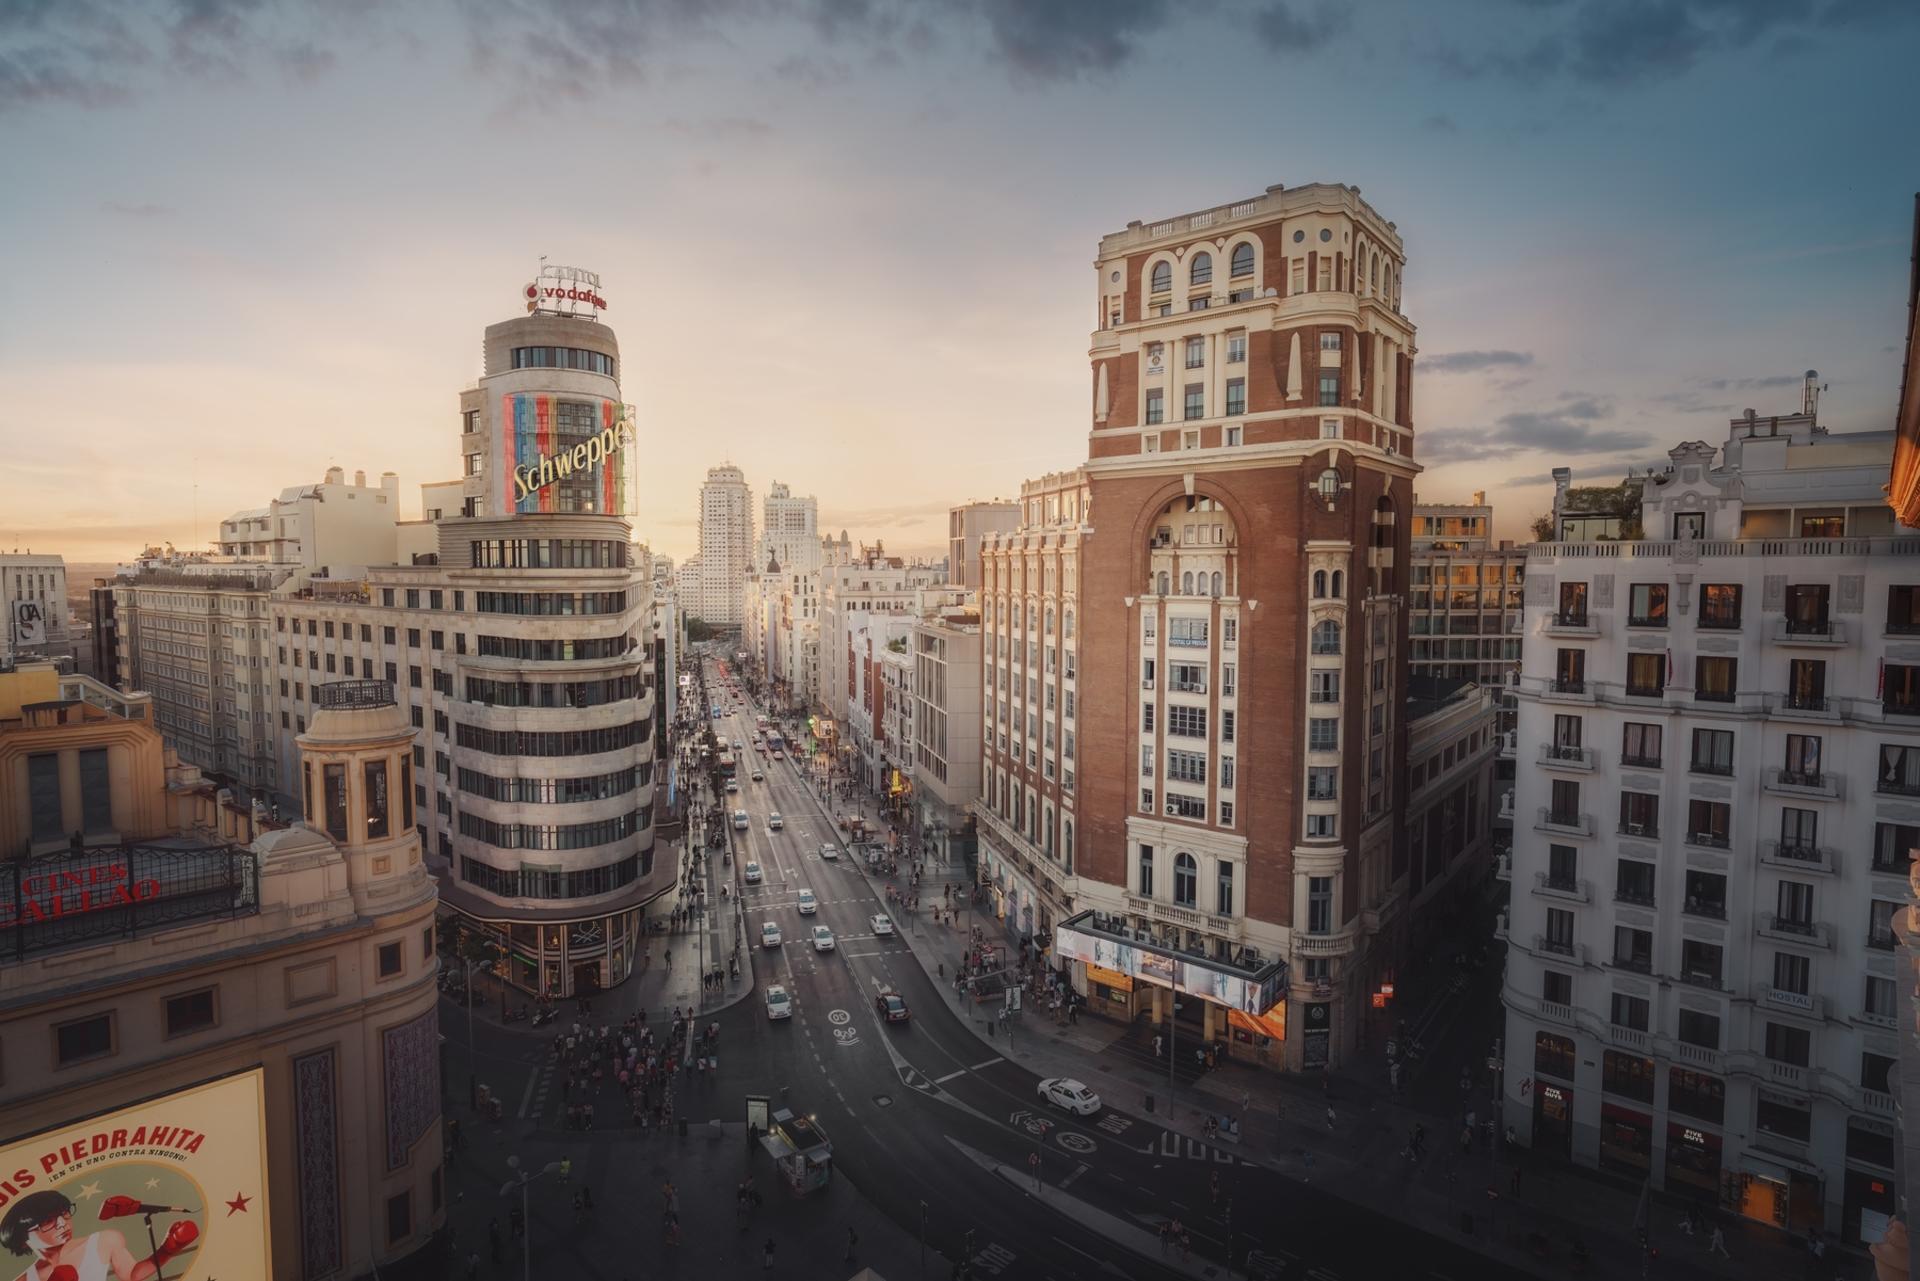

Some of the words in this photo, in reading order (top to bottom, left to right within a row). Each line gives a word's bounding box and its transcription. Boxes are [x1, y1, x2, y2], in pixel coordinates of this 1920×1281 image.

[544, 287, 607, 310] vodafone
[514, 418, 636, 503] Schweppes
[22, 863, 128, 896] CINES
[1769, 989, 1810, 1007] HOSTAL
[40, 1126, 205, 1174] PIEDRAHITA
[69, 1161, 83, 1173] UN
[86, 1154, 105, 1166] UNO
[109, 1149, 145, 1160] CONTRA
[148, 1148, 187, 1162] NINGUNO!
